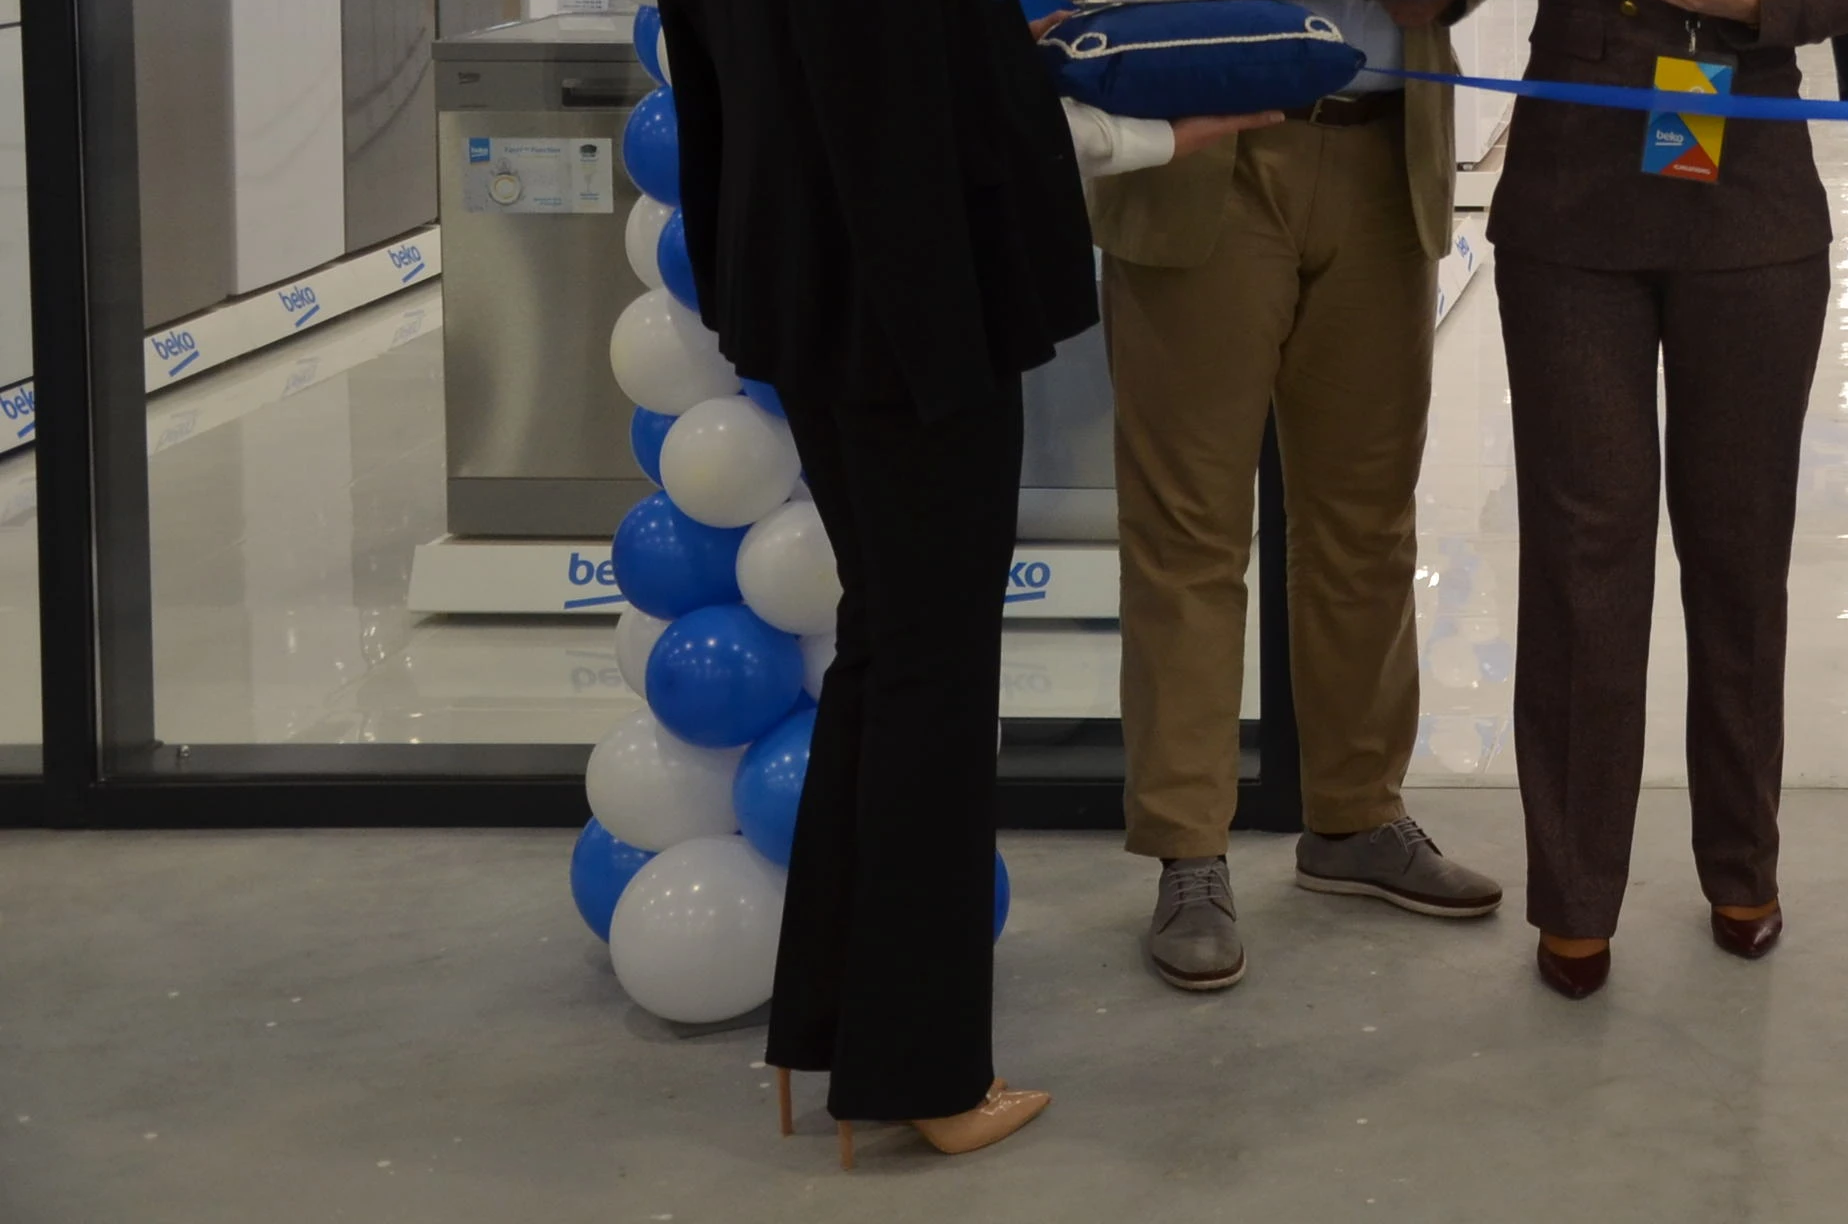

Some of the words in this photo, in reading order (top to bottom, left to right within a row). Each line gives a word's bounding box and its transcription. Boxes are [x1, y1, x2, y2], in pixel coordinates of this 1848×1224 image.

[1656, 129, 1684, 143] beko
[388, 245, 422, 268] beko
[279, 286, 317, 312] beko
[151, 331, 196, 360] beko
[1, 387, 35, 420] bek
[569, 552, 617, 586] be
